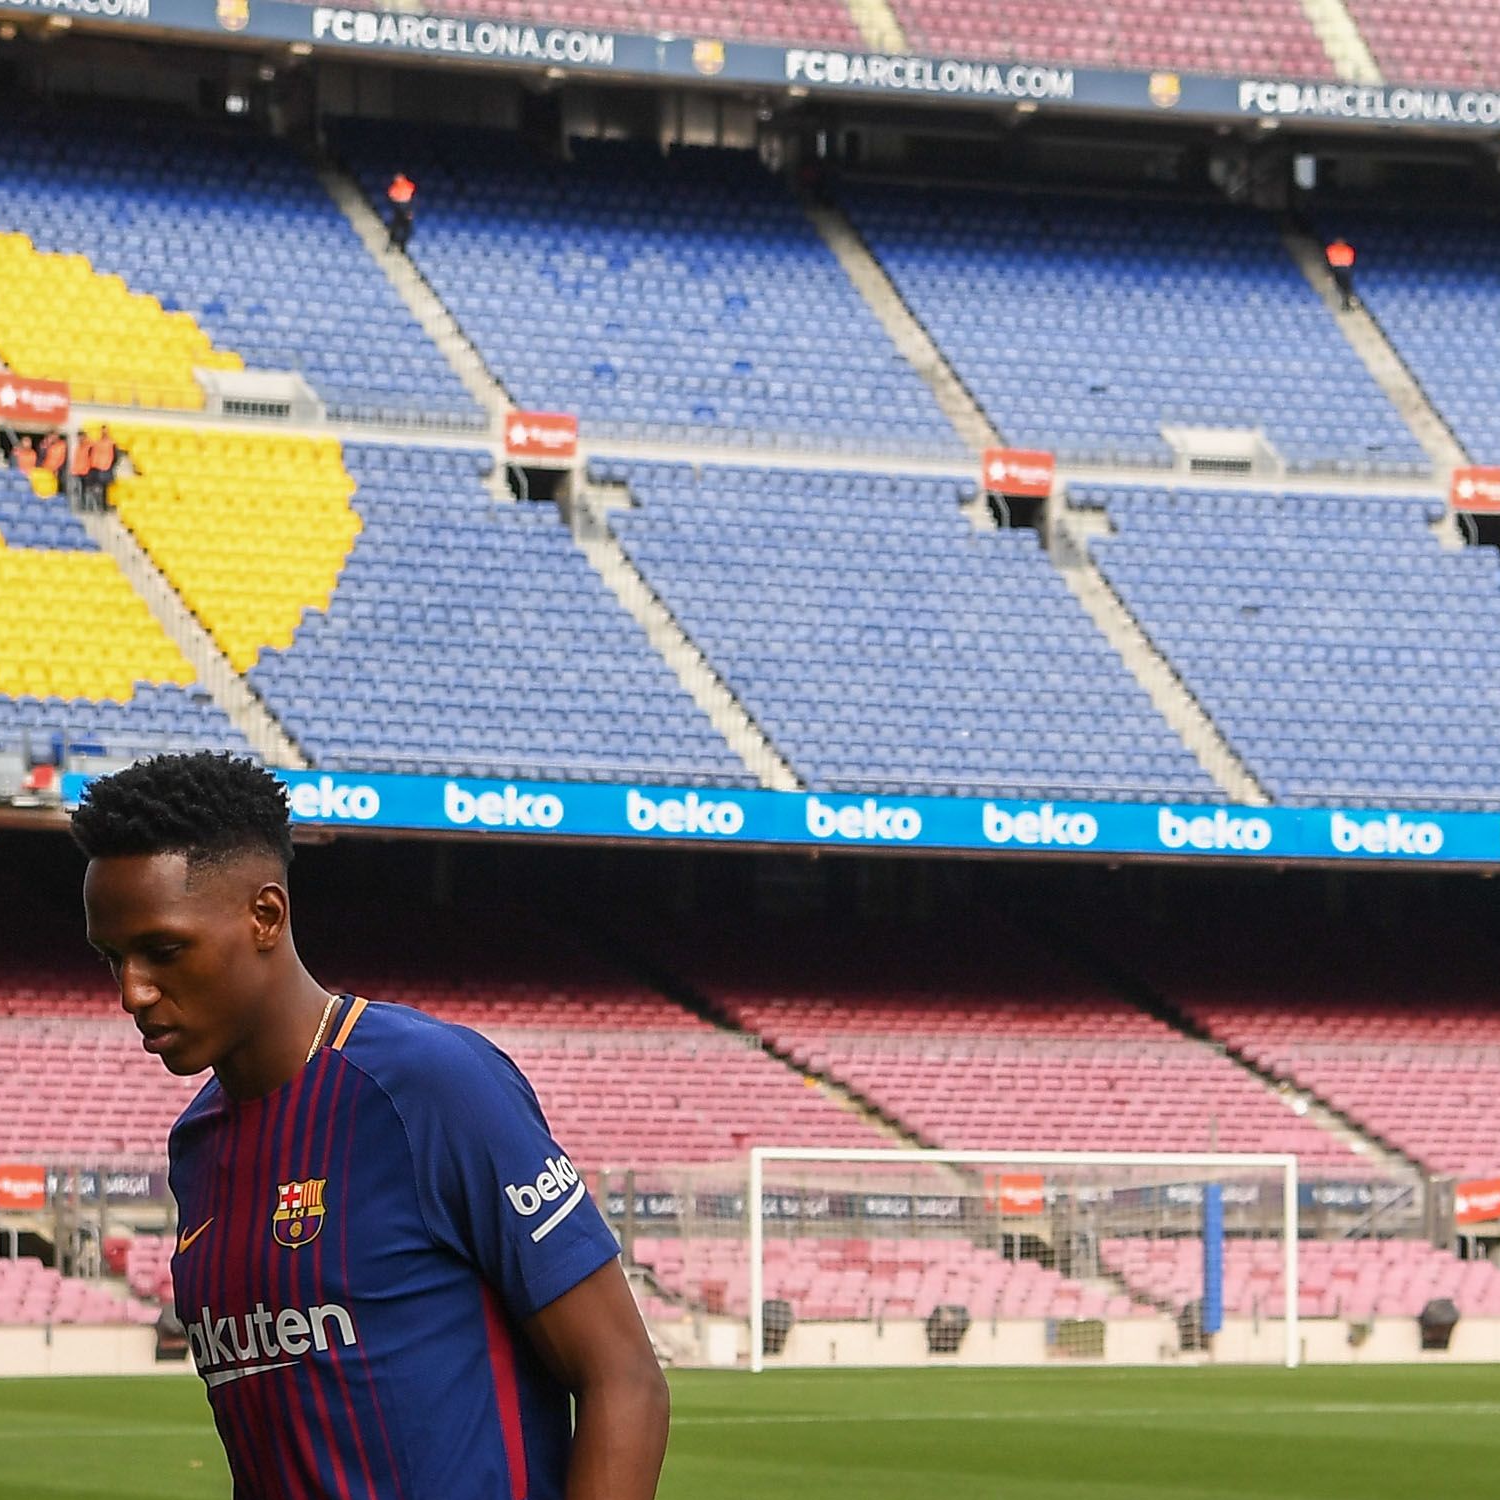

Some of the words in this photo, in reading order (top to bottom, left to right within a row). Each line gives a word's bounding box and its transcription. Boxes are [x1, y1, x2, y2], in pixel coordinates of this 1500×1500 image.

[312, 8, 614, 65] FCBARCELONA.COM
[785, 50, 1074, 99] FCBARCELONA.COM
[291, 776, 380, 819] eko
[444, 782, 564, 828] beko
[627, 790, 744, 834] beko
[806, 797, 922, 840] beko
[983, 803, 1098, 845] beko
[1158, 808, 1272, 850] beko
[1331, 813, 1443, 854] beko
[505, 1155, 579, 1215] beko
[187, 1302, 357, 1369] akuten
